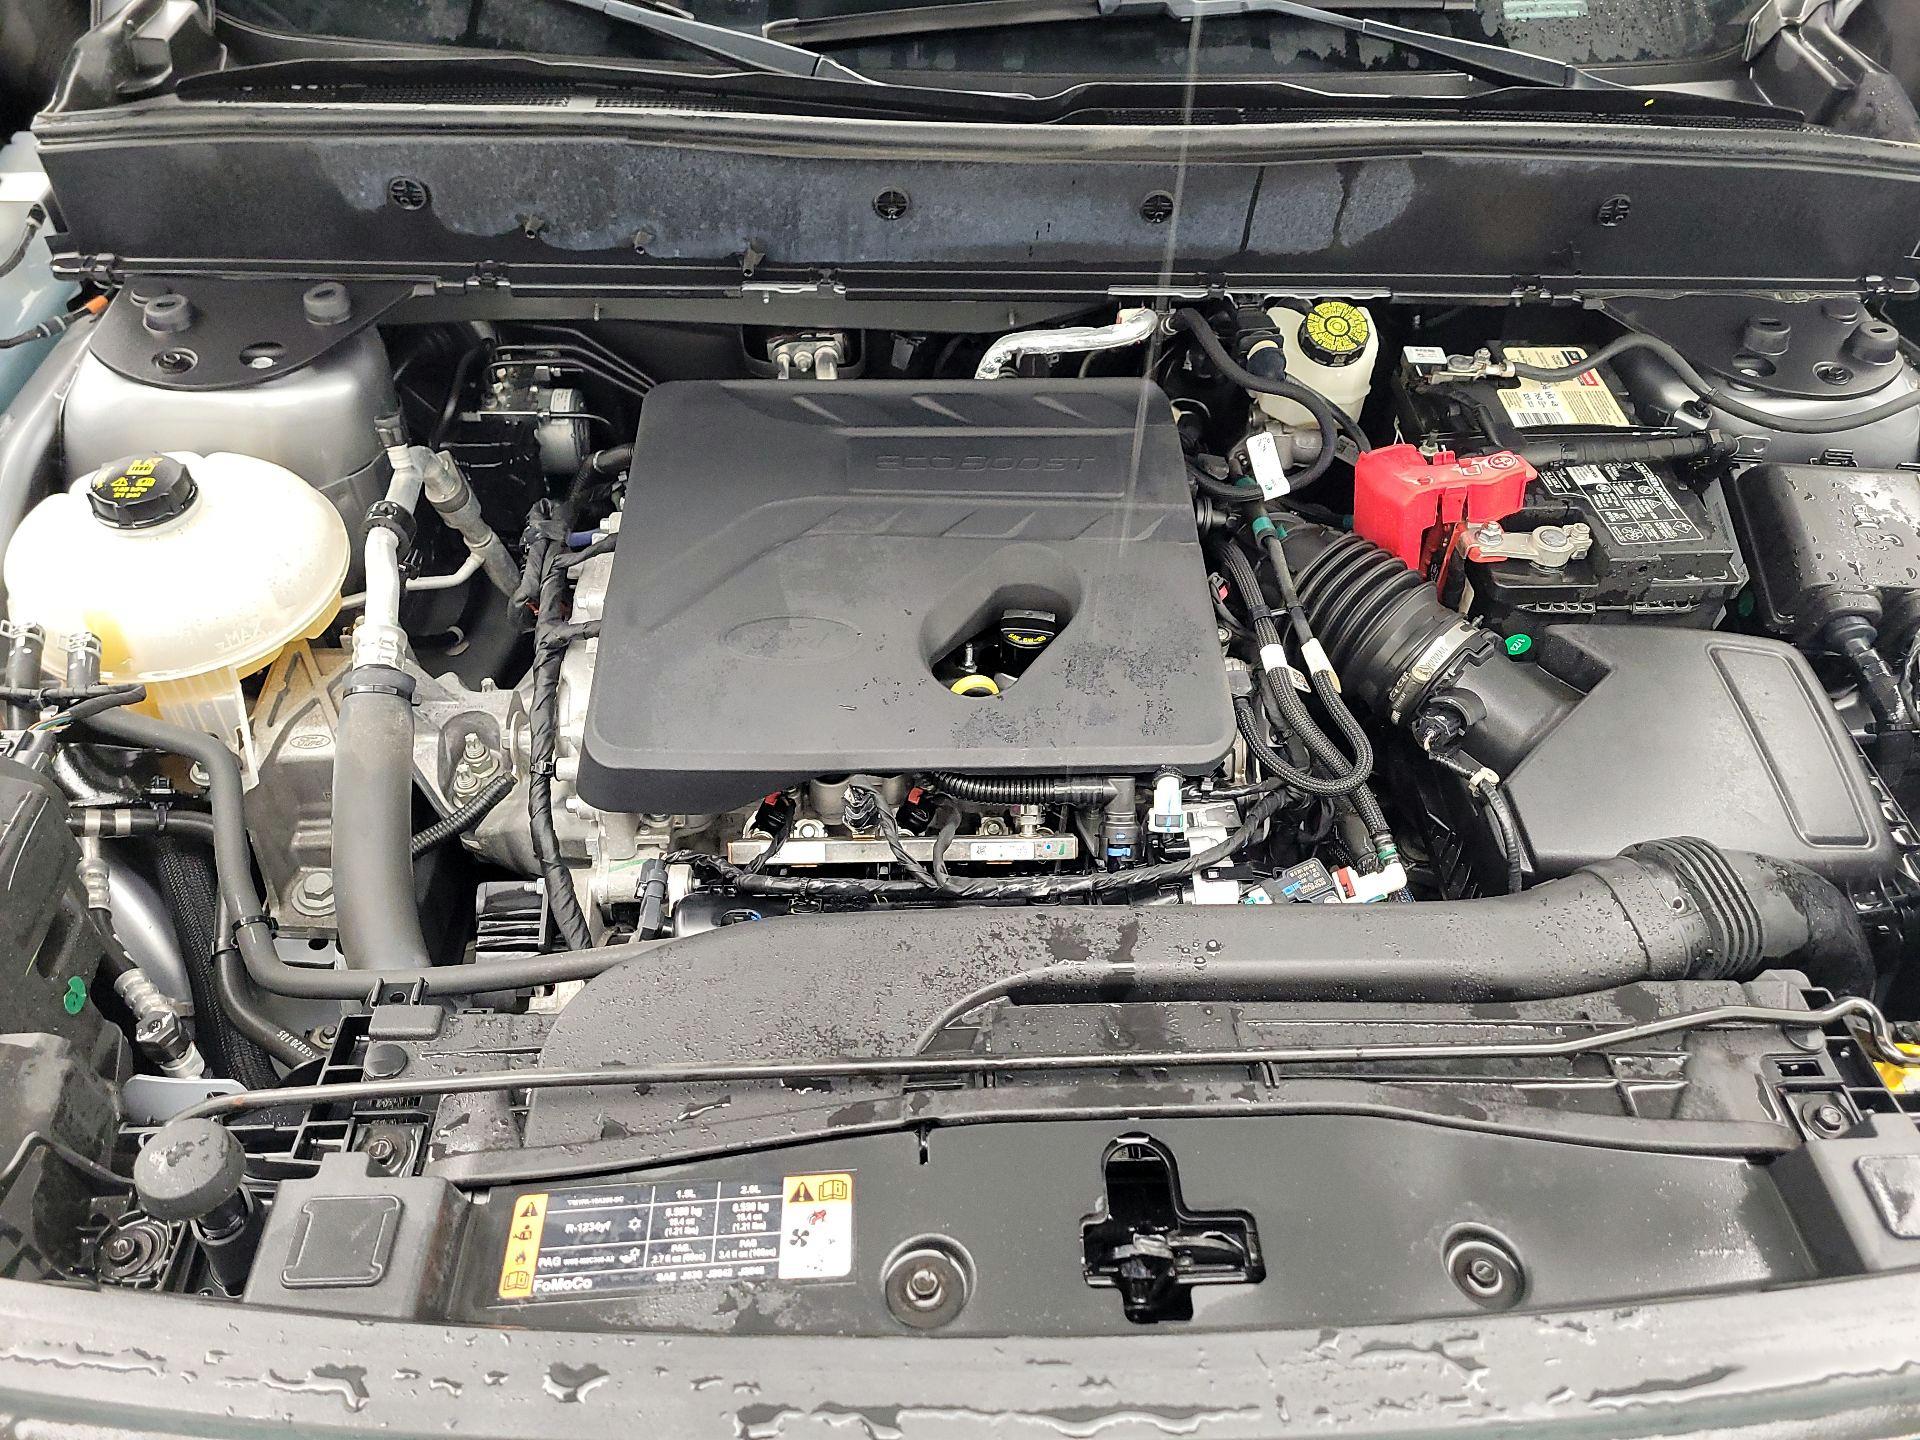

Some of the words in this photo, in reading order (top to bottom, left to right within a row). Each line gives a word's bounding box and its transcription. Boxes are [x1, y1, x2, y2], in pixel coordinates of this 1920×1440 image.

[875, 455, 1097, 472] ECOBOOST
[538, 1256, 562, 1268] PAG
[532, 1276, 593, 1293] FoMoCo
